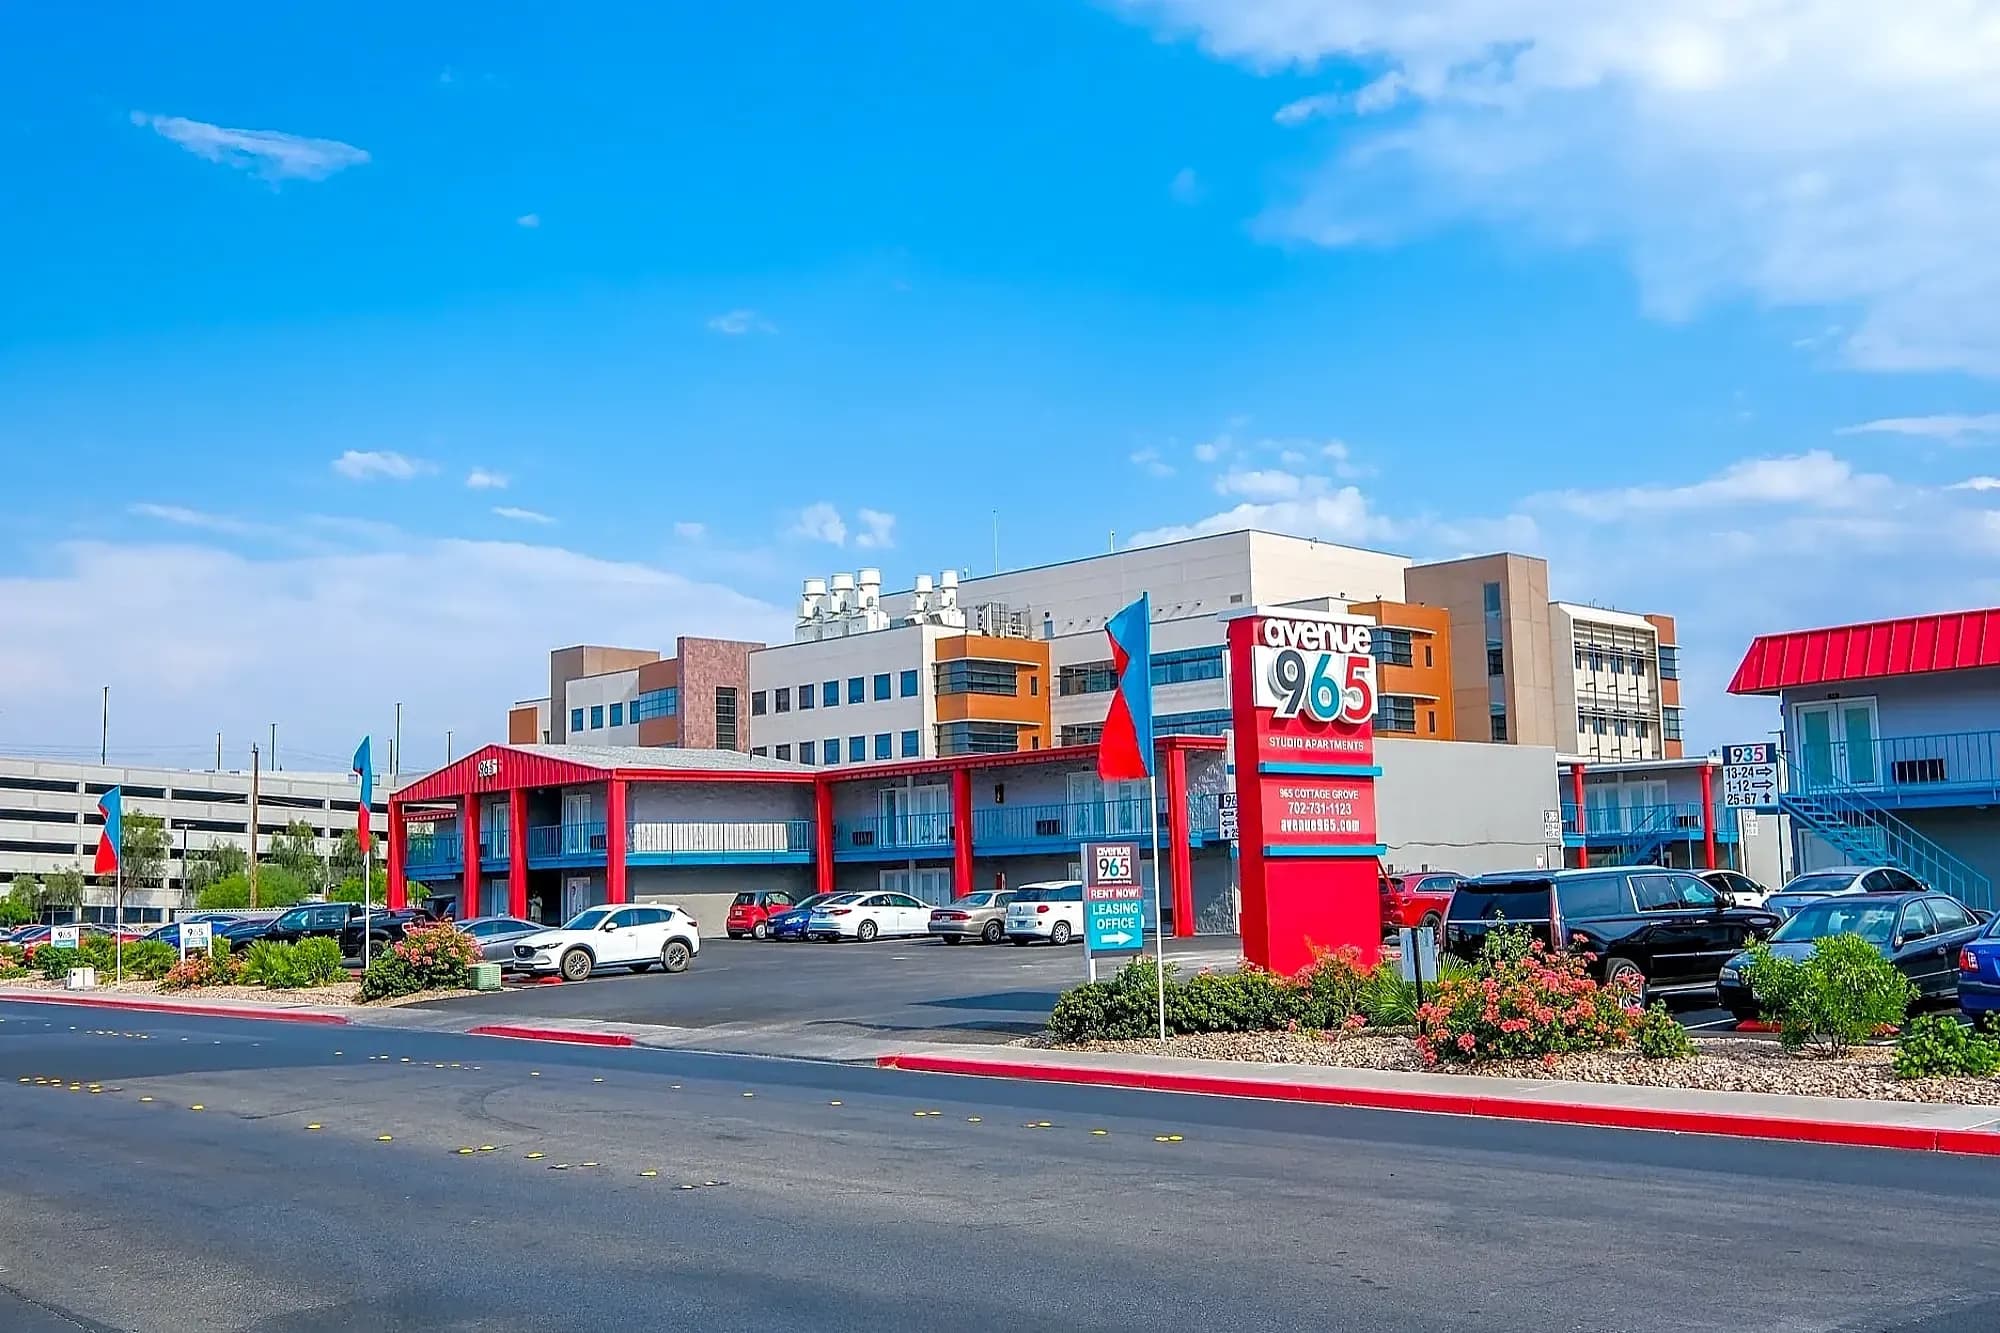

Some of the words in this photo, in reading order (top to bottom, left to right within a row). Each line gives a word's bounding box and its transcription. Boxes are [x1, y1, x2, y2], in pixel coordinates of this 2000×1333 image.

[1263, 618, 1372, 654] avenue
[1270, 649, 1373, 723] 965
[1268, 736, 1303, 749] STUDIO
[1304, 738, 1364, 751] APARTMENTS
[1733, 746, 1764, 762] 935
[1726, 766, 1754, 779] 13-24
[1726, 779, 1750, 792] 1-12
[1279, 788, 1294, 798] 965
[1294, 788, 1331, 799] COTTAGE
[1331, 789, 1359, 800] GROVE
[1727, 792, 1757, 805] 25-67
[1287, 801, 1352, 815] 702-731-1123
[1280, 818, 1360, 832] avenue965.com
[1096, 846, 1131, 856] avenue
[1098, 857, 1130, 878] 965
[1090, 888, 1114, 899] RENT
[1115, 888, 1139, 899] NOW!
[1092, 902, 1139, 916] LEASING
[1096, 917, 1136, 930] OFFICE
